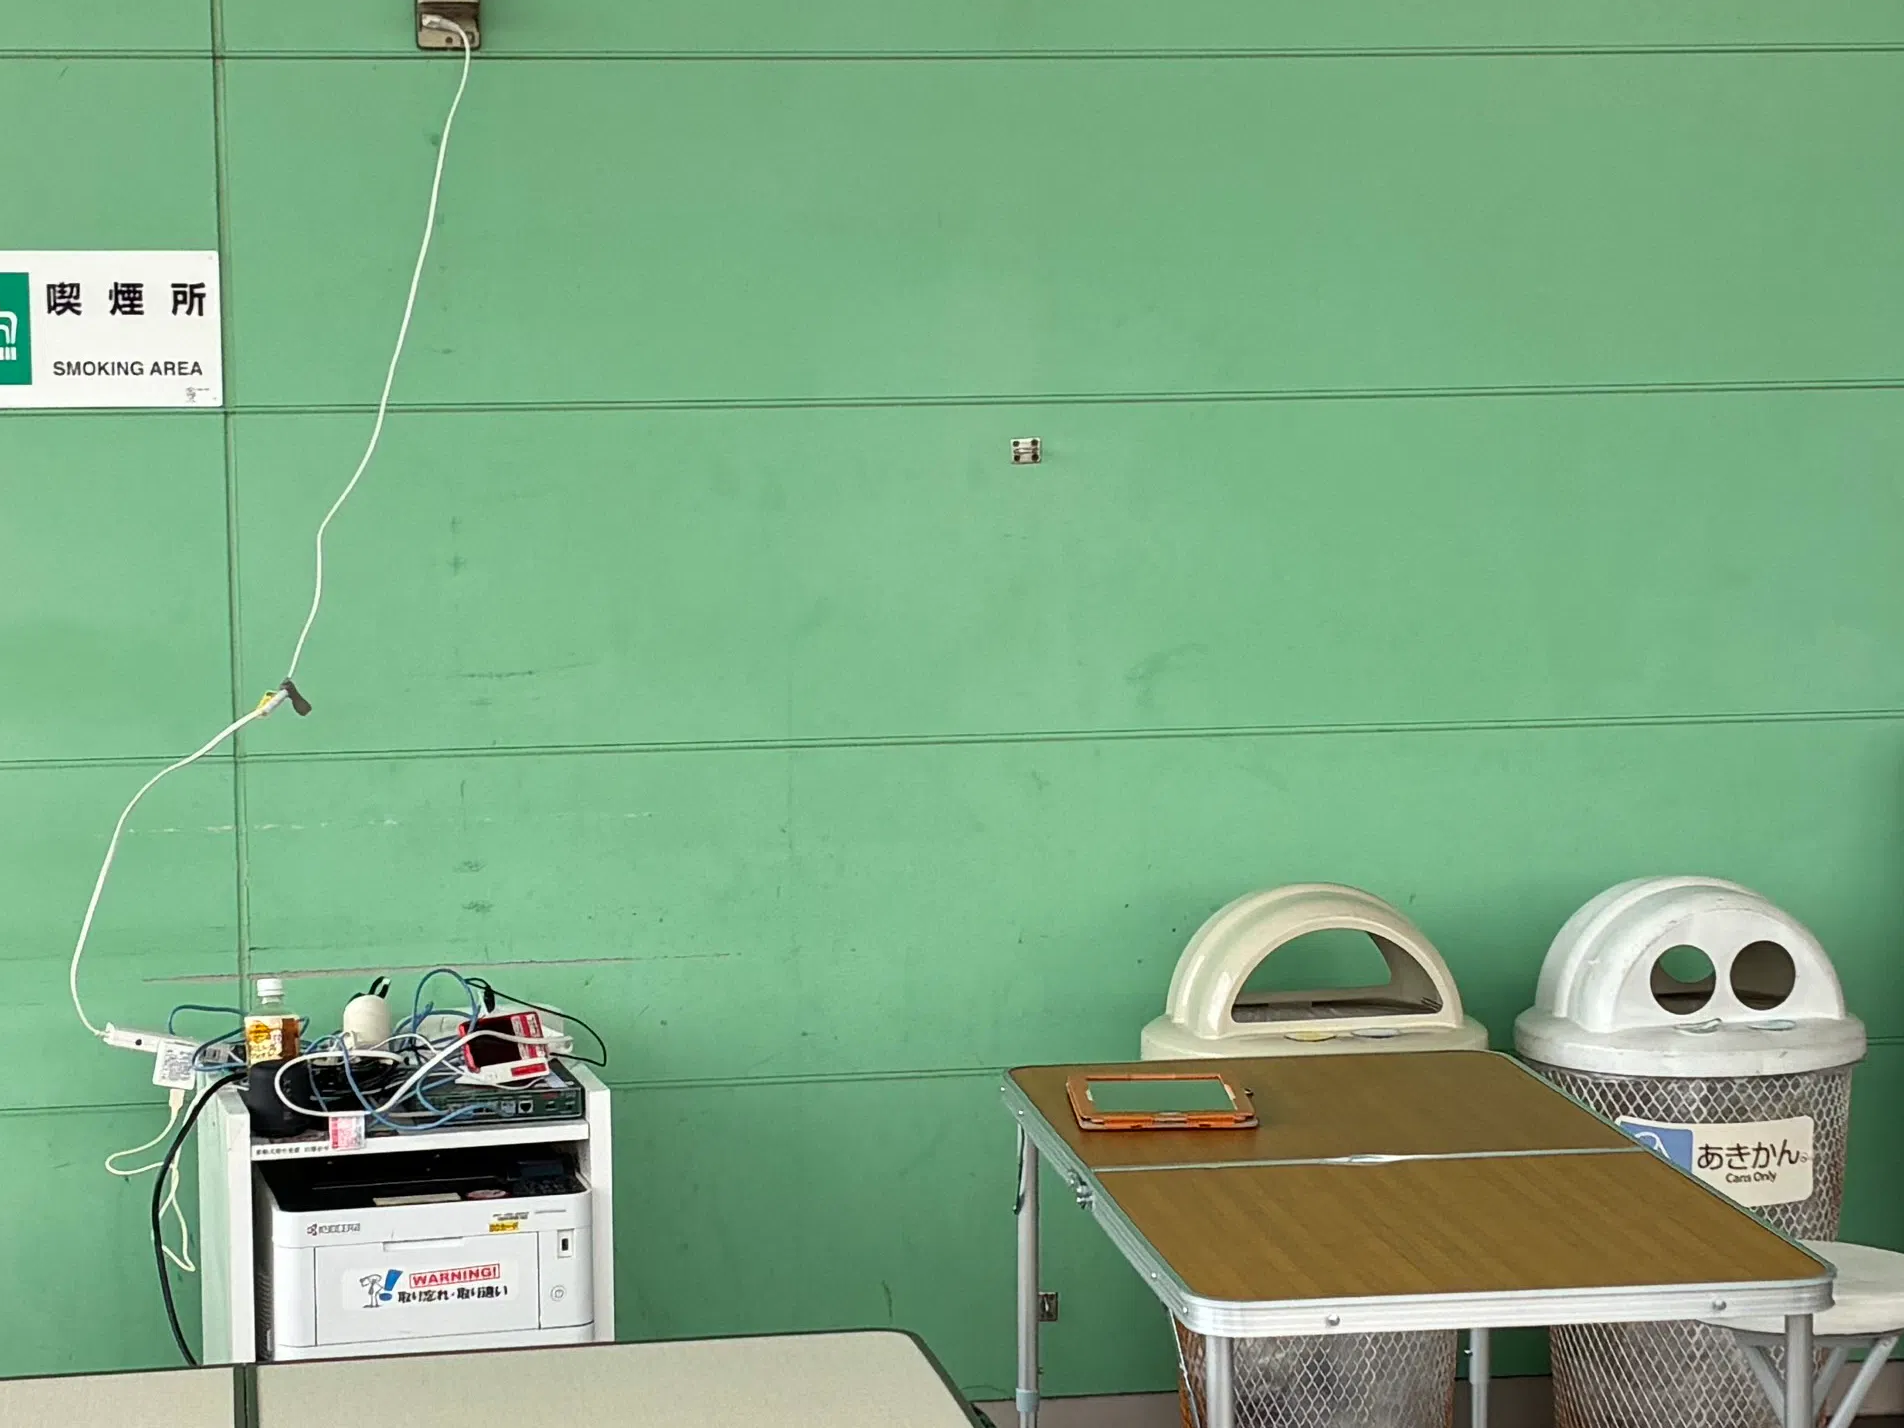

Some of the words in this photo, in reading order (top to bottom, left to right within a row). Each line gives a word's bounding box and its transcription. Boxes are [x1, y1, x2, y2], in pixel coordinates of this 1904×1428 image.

[1697, 1138, 1800, 1170] あきかん
[1726, 1172, 1752, 1184] Cans
[1754, 1171, 1777, 1184] Only
[413, 1266, 497, 1287] WARNING!
